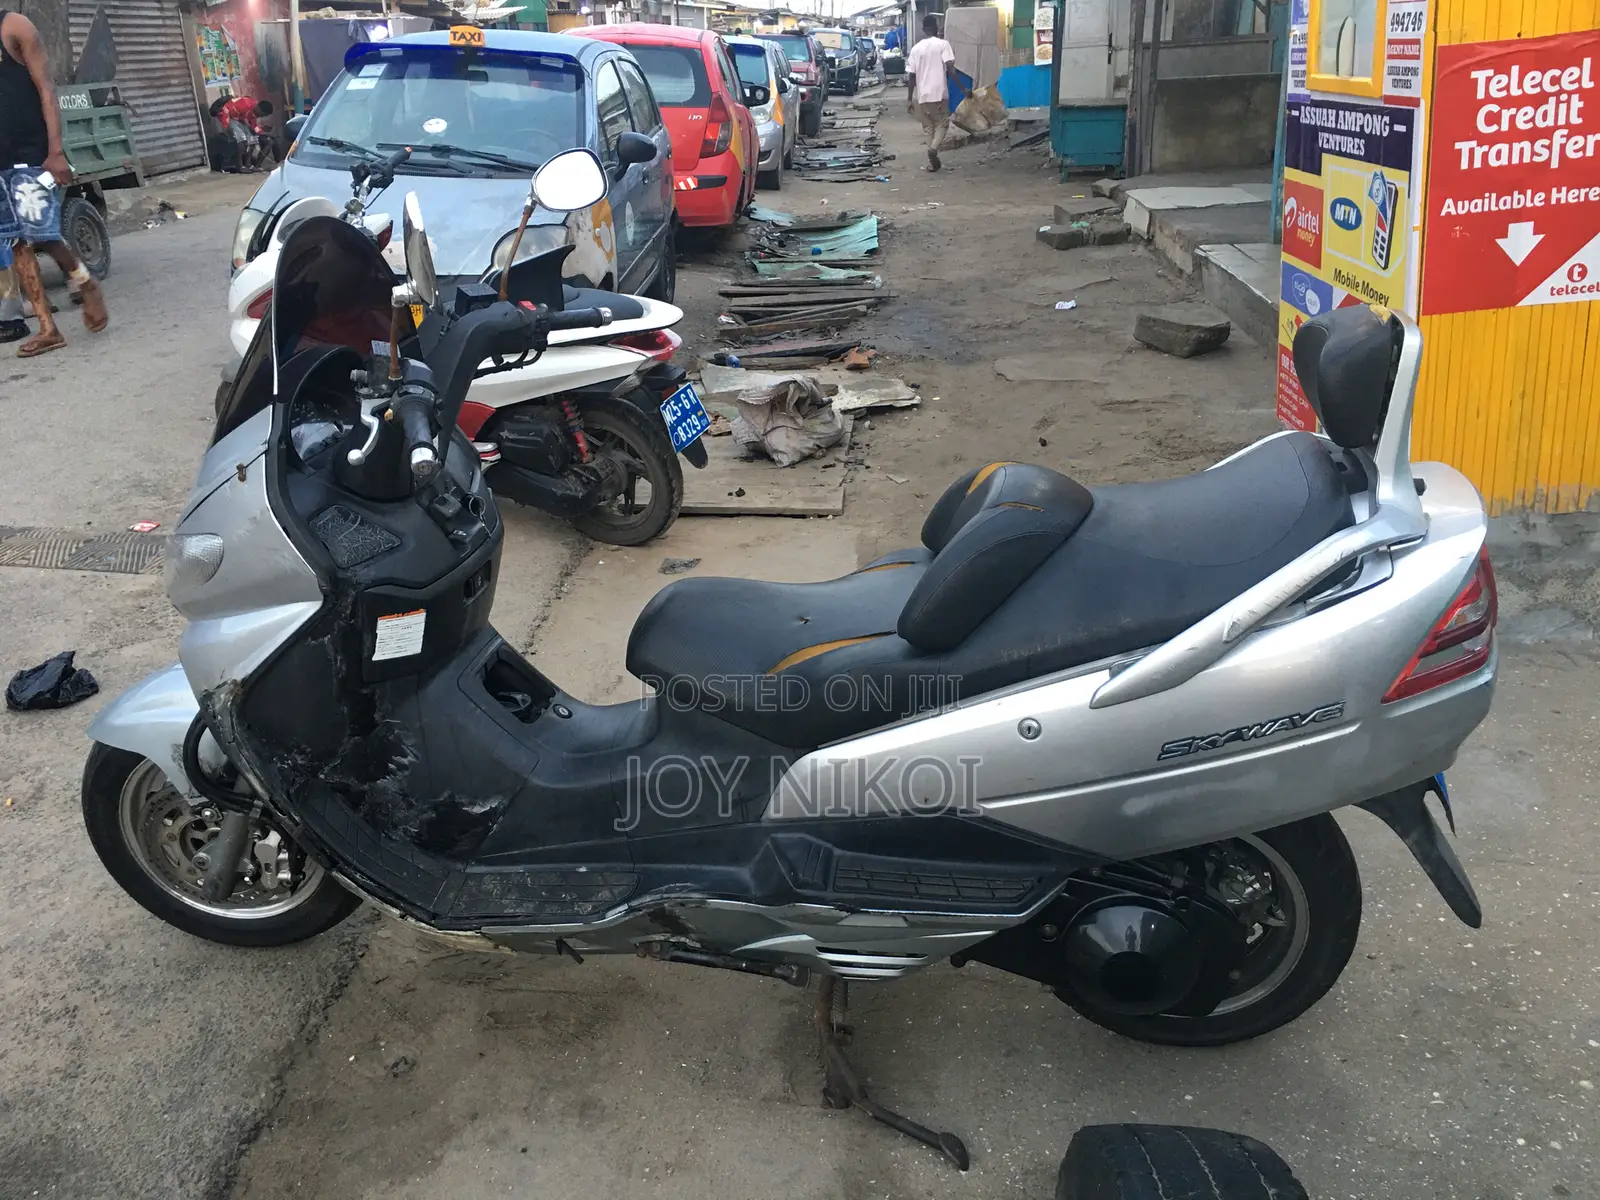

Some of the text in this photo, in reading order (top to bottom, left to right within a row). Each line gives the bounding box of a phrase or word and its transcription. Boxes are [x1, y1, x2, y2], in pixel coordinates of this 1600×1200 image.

[450, 31, 482, 42] TAXI
[1390, 11, 1424, 33] 494746
[1470, 57, 1595, 100] Telecel
[1299, 105, 1390, 137] ASSUAH AMPONG
[1476, 93, 1585, 134] Credit
[1318, 131, 1366, 156] VENTURES
[1454, 128, 1600, 170] Transfer
[1334, 203, 1357, 226] MTN
[1440, 186, 1600, 217] Available Here
[1297, 206, 1320, 235] airtel
[1297, 229, 1316, 247] money
[1333, 267, 1390, 308] Mobile Money
[1550, 281, 1600, 297] telecel
[677, 414, 702, 442] 8329
[1157, 699, 1347, 761] SKYWAVE
